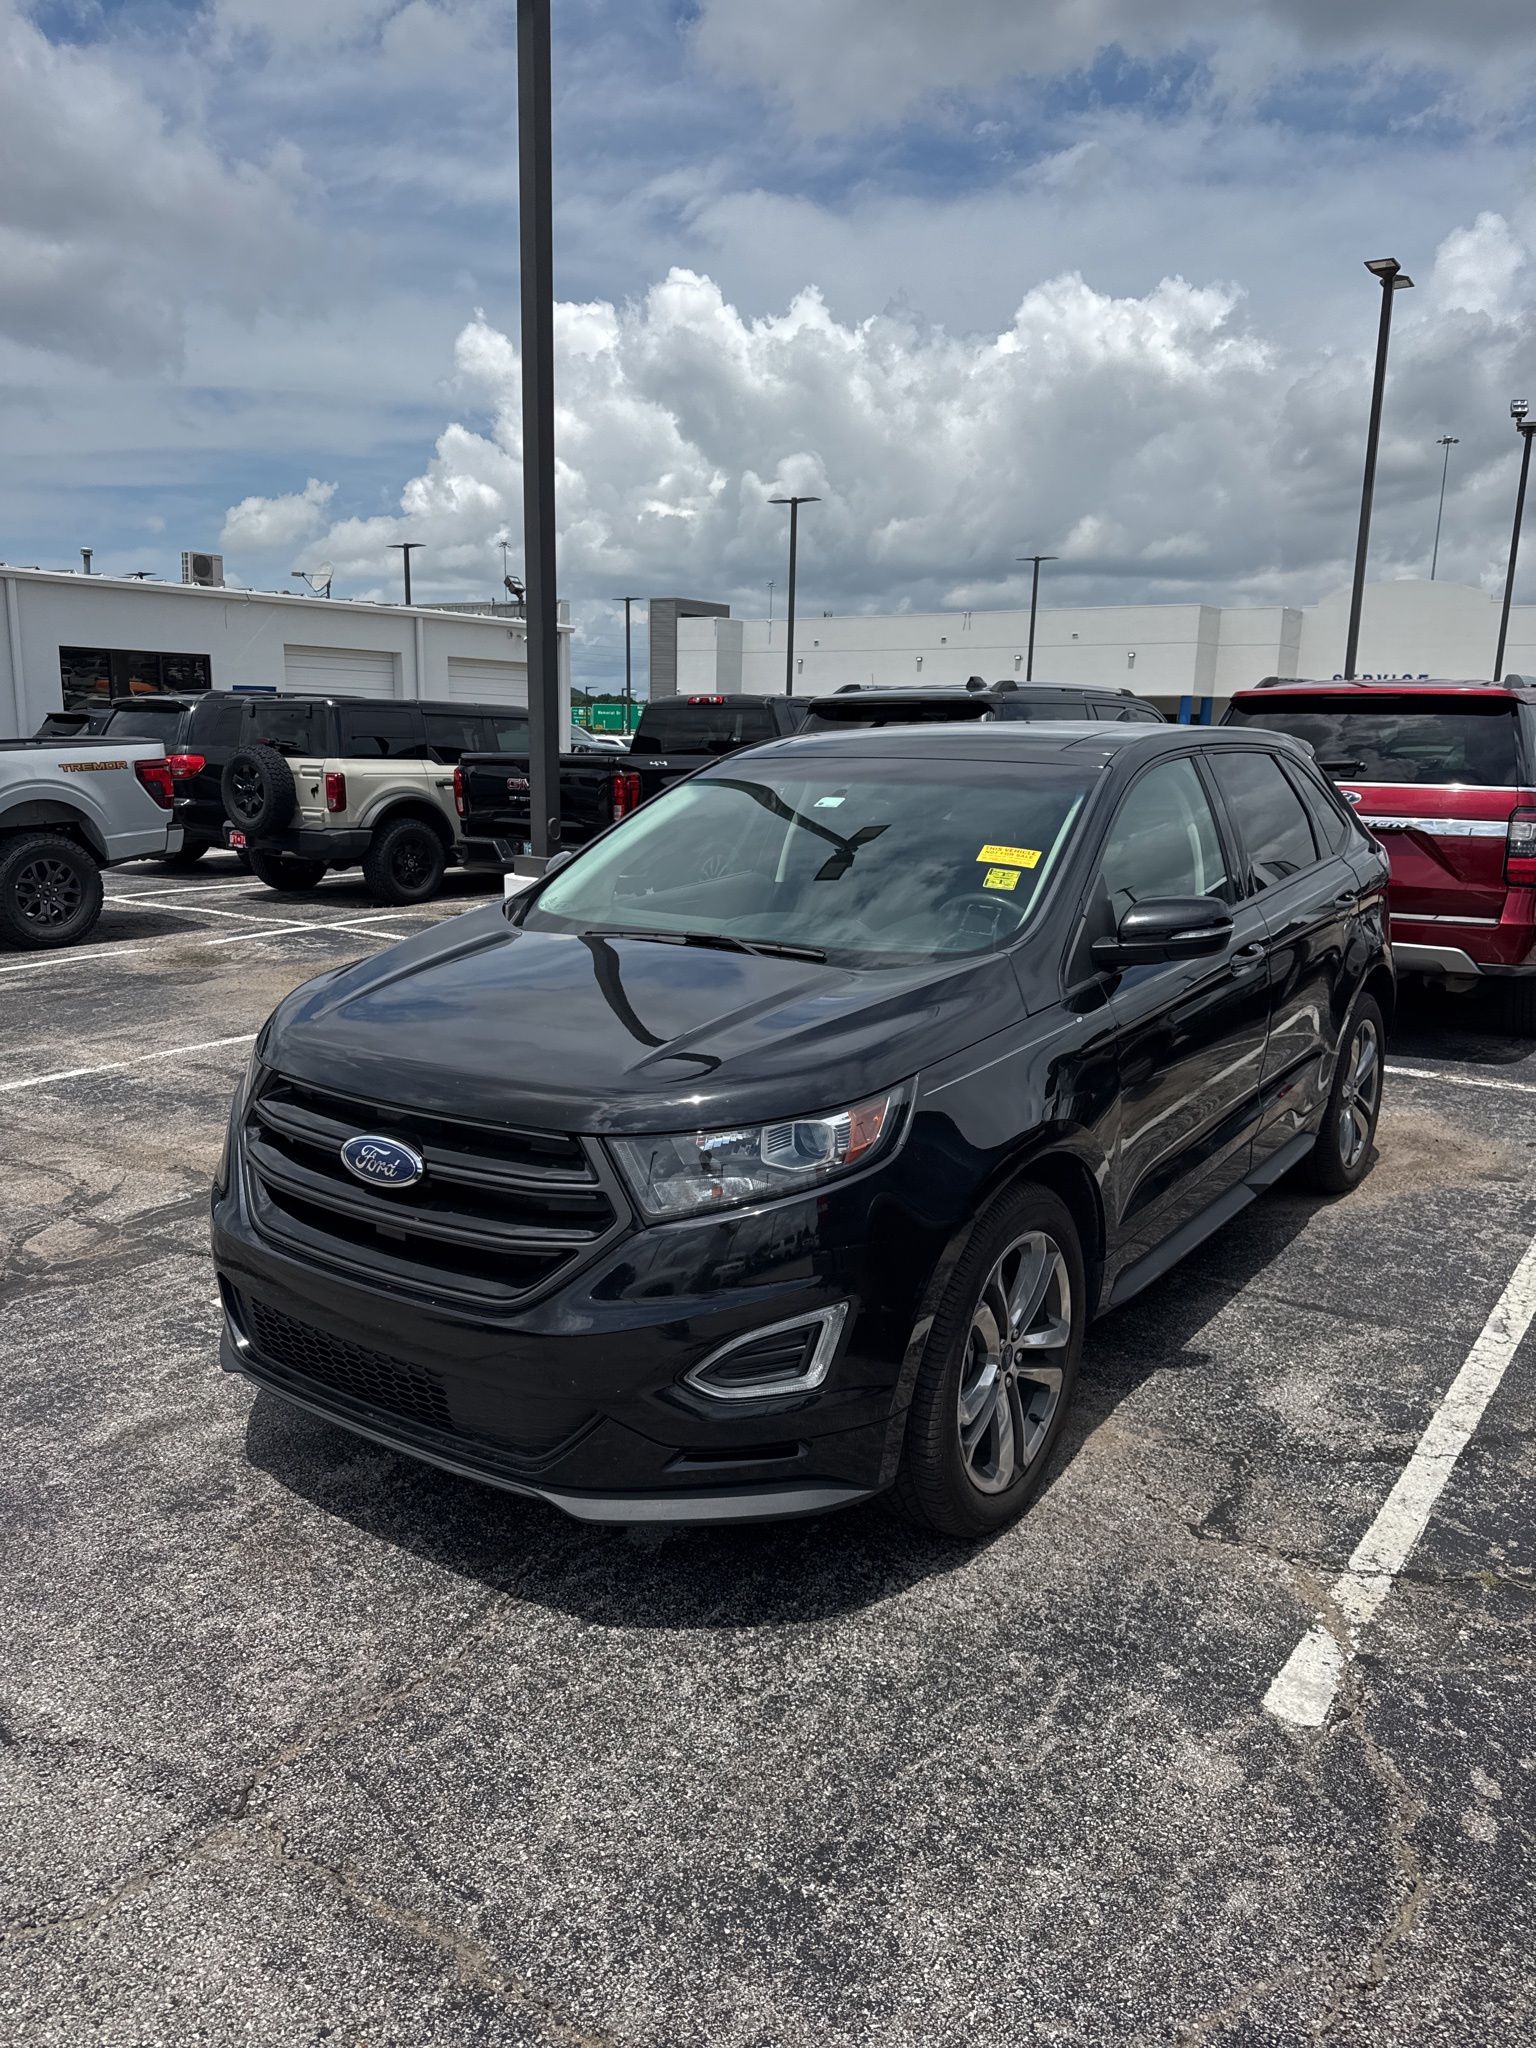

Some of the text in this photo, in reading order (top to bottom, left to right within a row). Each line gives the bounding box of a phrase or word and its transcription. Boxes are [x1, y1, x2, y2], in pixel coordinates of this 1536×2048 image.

[58, 761, 128, 772] TREMOR
[507, 778, 530, 790] GM
[1004, 847, 1037, 856] VEHICLE
[356, 1145, 401, 1177] Ford
